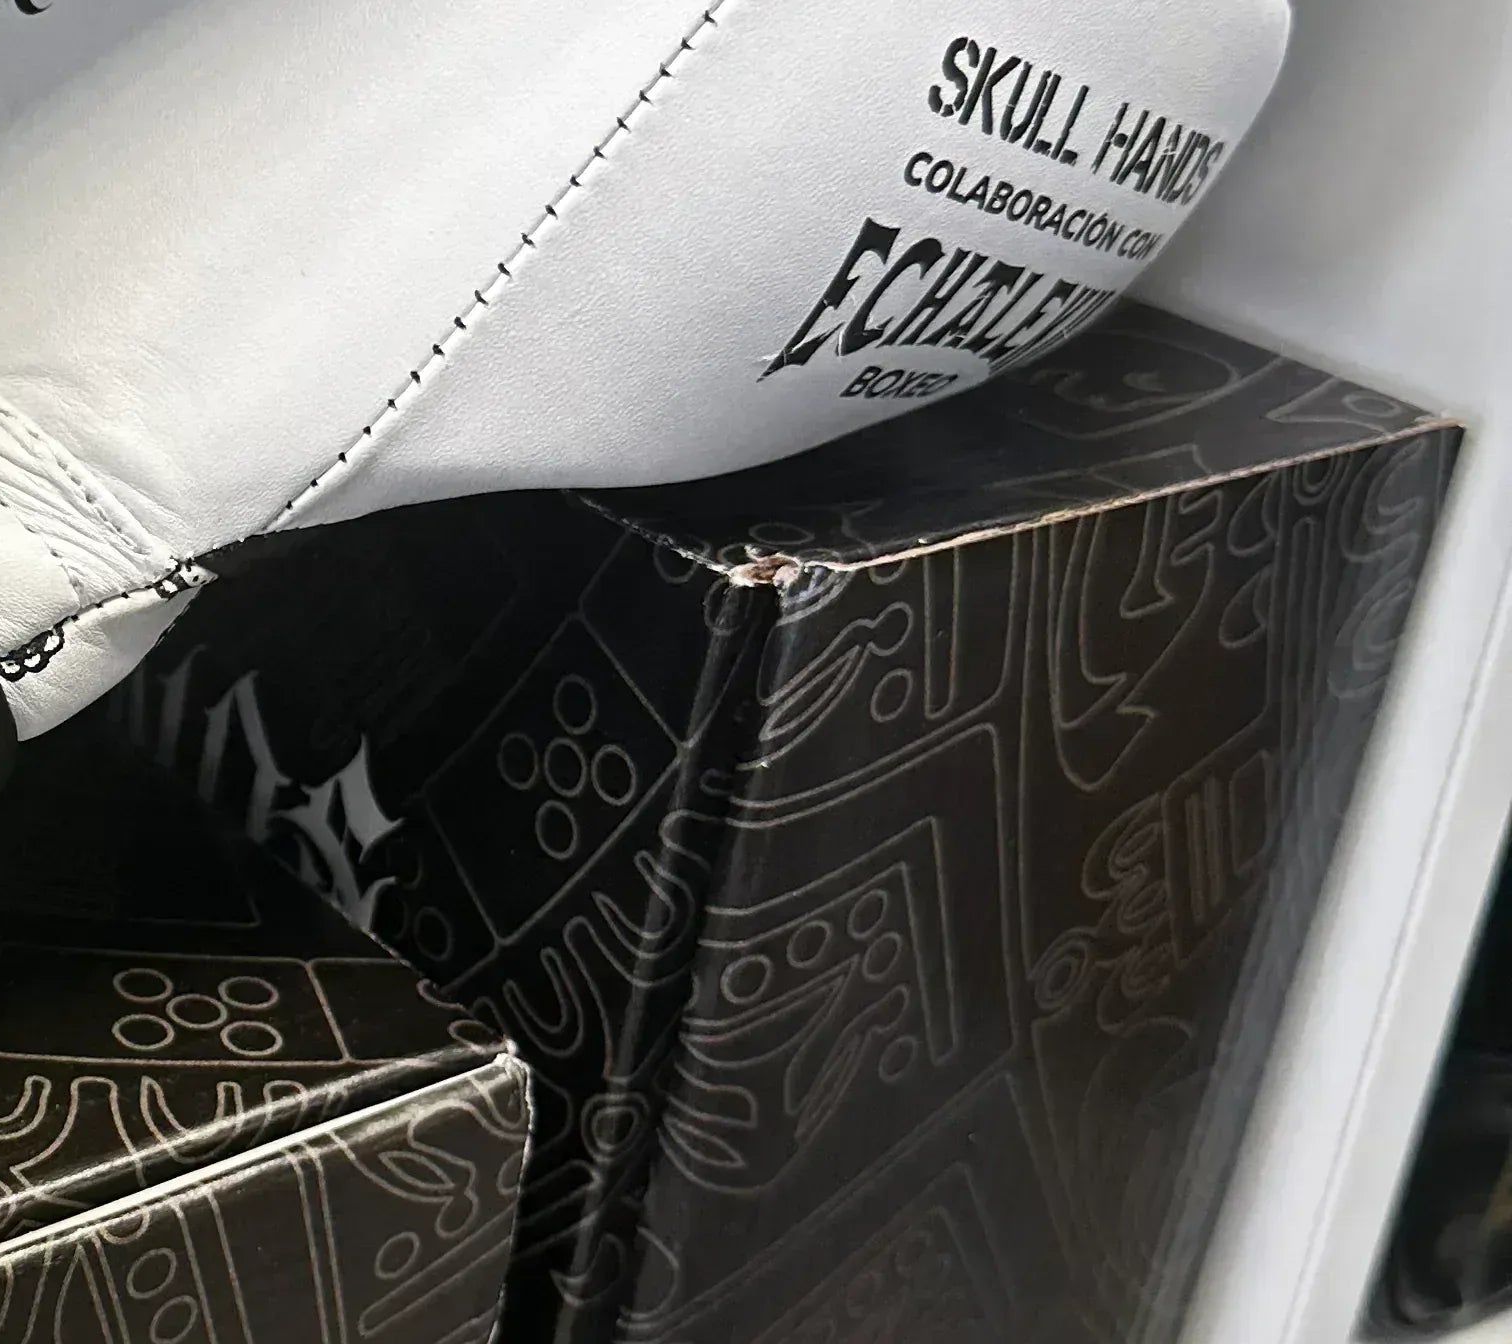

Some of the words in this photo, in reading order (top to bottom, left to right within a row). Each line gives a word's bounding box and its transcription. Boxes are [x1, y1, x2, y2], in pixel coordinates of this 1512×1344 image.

[928, 36, 1089, 166] SKULL
[1090, 102, 1225, 206] HANDS
[904, 152, 1126, 253] COLABORACIÓN
[1116, 228, 1164, 260] CON
